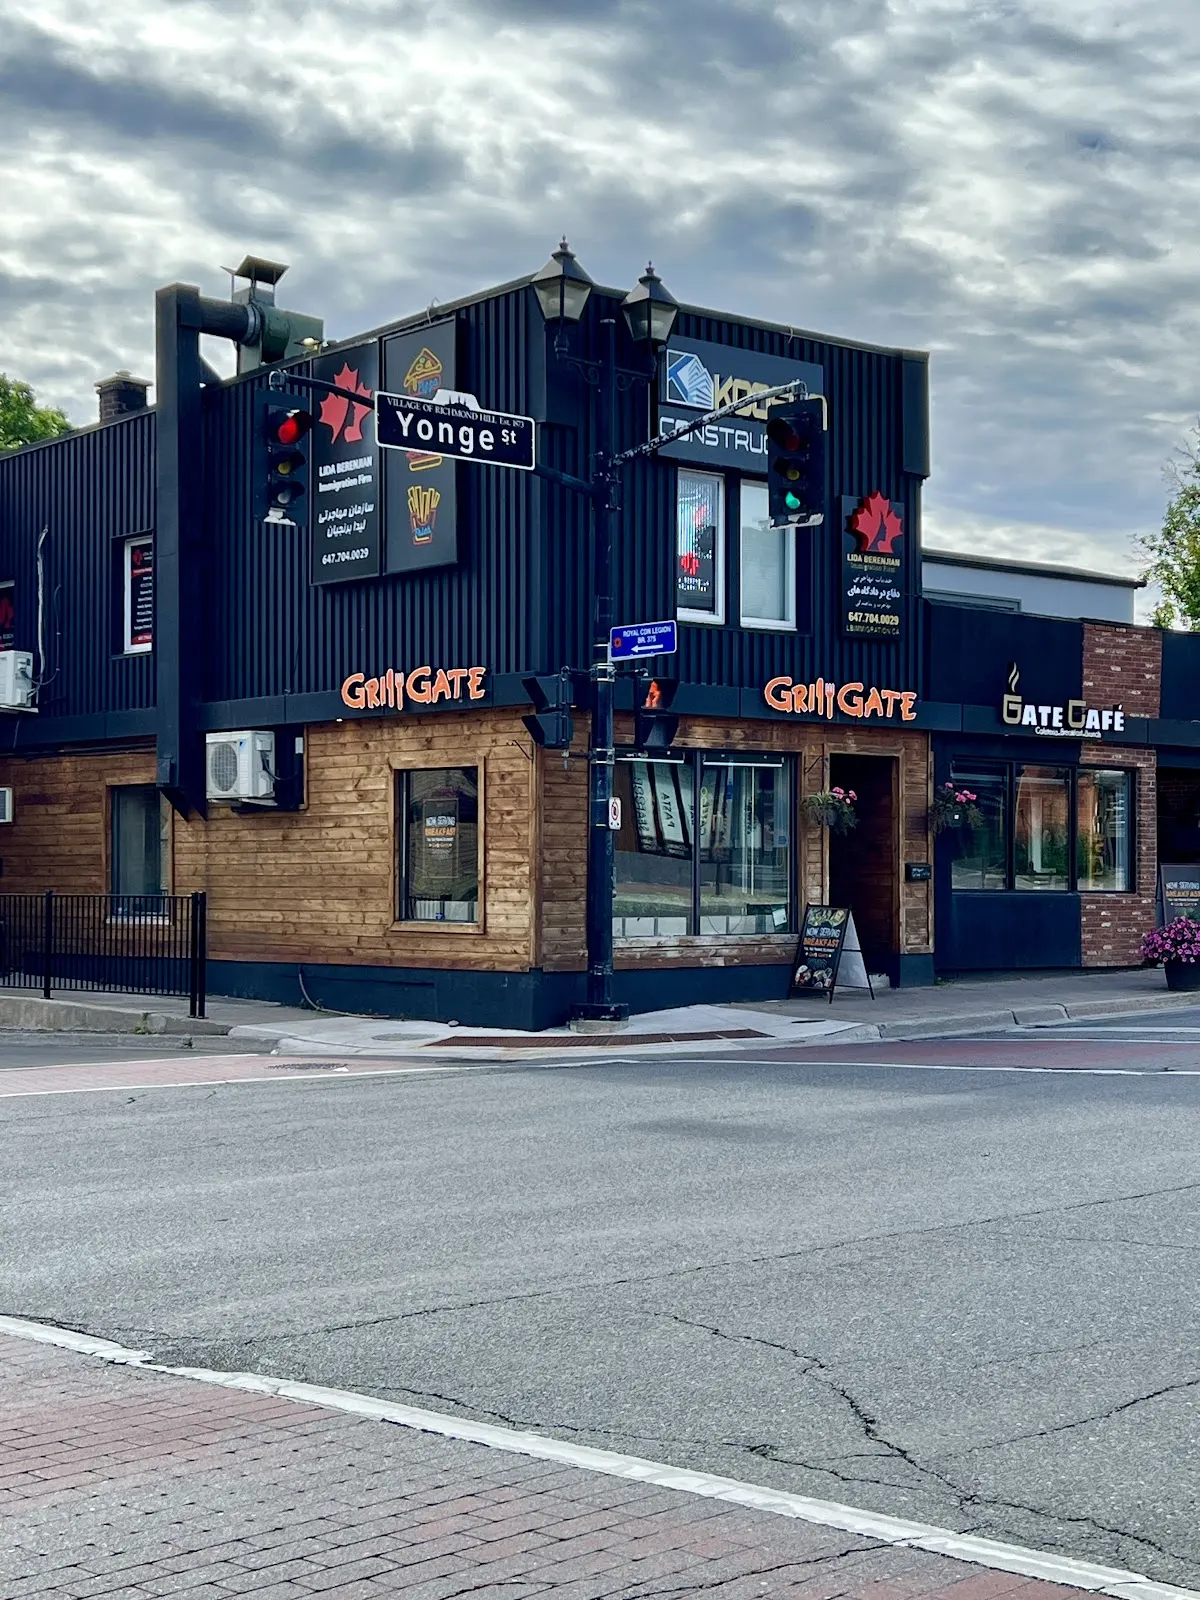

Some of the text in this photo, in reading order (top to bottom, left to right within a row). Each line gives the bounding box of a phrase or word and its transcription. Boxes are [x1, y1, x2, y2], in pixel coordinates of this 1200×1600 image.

[387, 396, 421, 411] VILLAGE
[422, 403, 434, 413] OF
[435, 405, 479, 420] RICHMOND
[396, 410, 517, 454] Yonge St
[318, 462, 337, 477] LIDA
[318, 473, 373, 492] Immigration Firm
[322, 547, 369, 565] 647.704.0029
[846, 553, 863, 563] LIDA
[848, 611, 900, 626] 647.704.0029
[623, 629, 639, 638] ROYAL
[652, 625, 672, 634] LEGION
[405, 665, 487, 704] GATE
[836, 682, 918, 721] GATE
[1002, 693, 1125, 732] GATE CAFÉ
[806, 927, 841, 938] NOW SERVING
[803, 937, 840, 948] BREAKFAST
